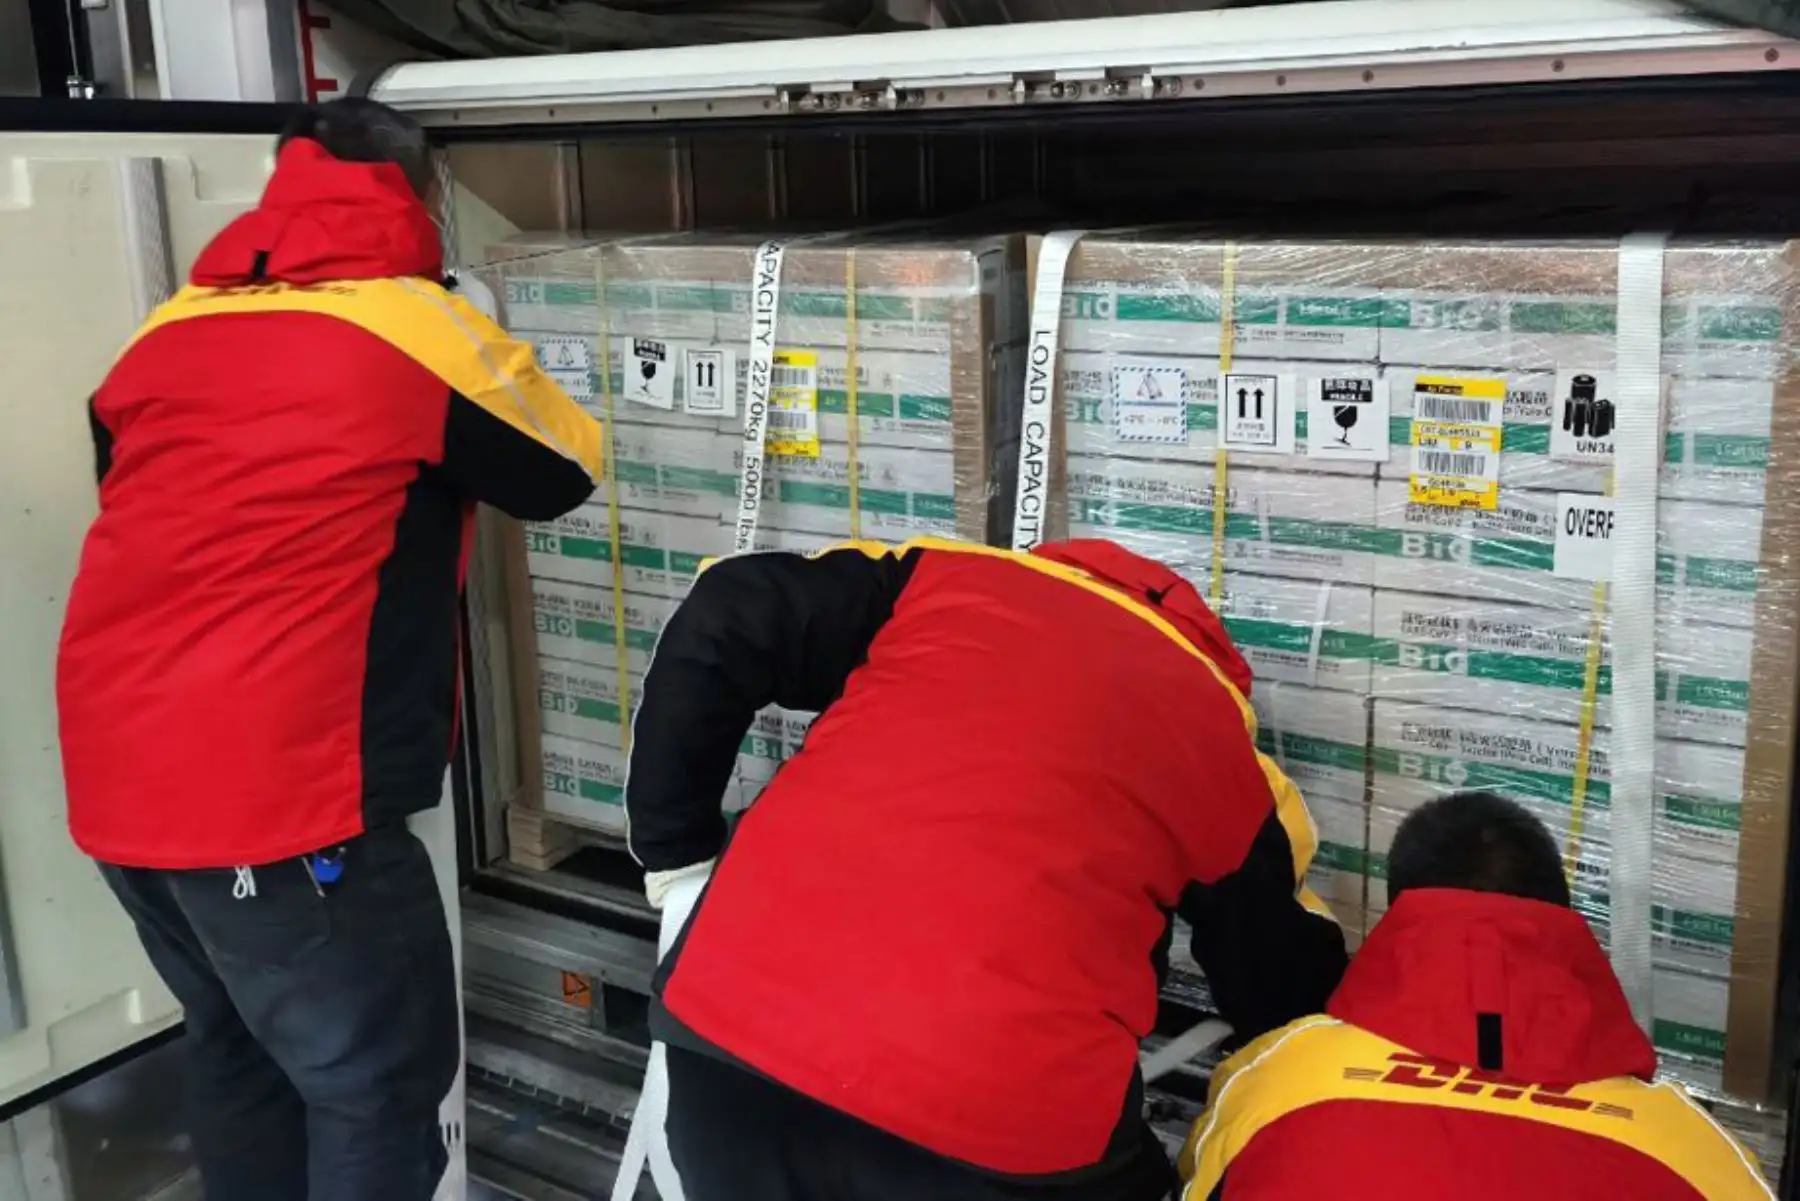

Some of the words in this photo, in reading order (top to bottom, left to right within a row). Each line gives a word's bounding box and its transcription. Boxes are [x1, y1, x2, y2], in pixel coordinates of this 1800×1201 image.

[745, 360, 768, 441] 2270kg
[1029, 330, 1051, 404] LOAD
[743, 457, 761, 510] 5000
[1018, 421, 1044, 553] CAPACITY
